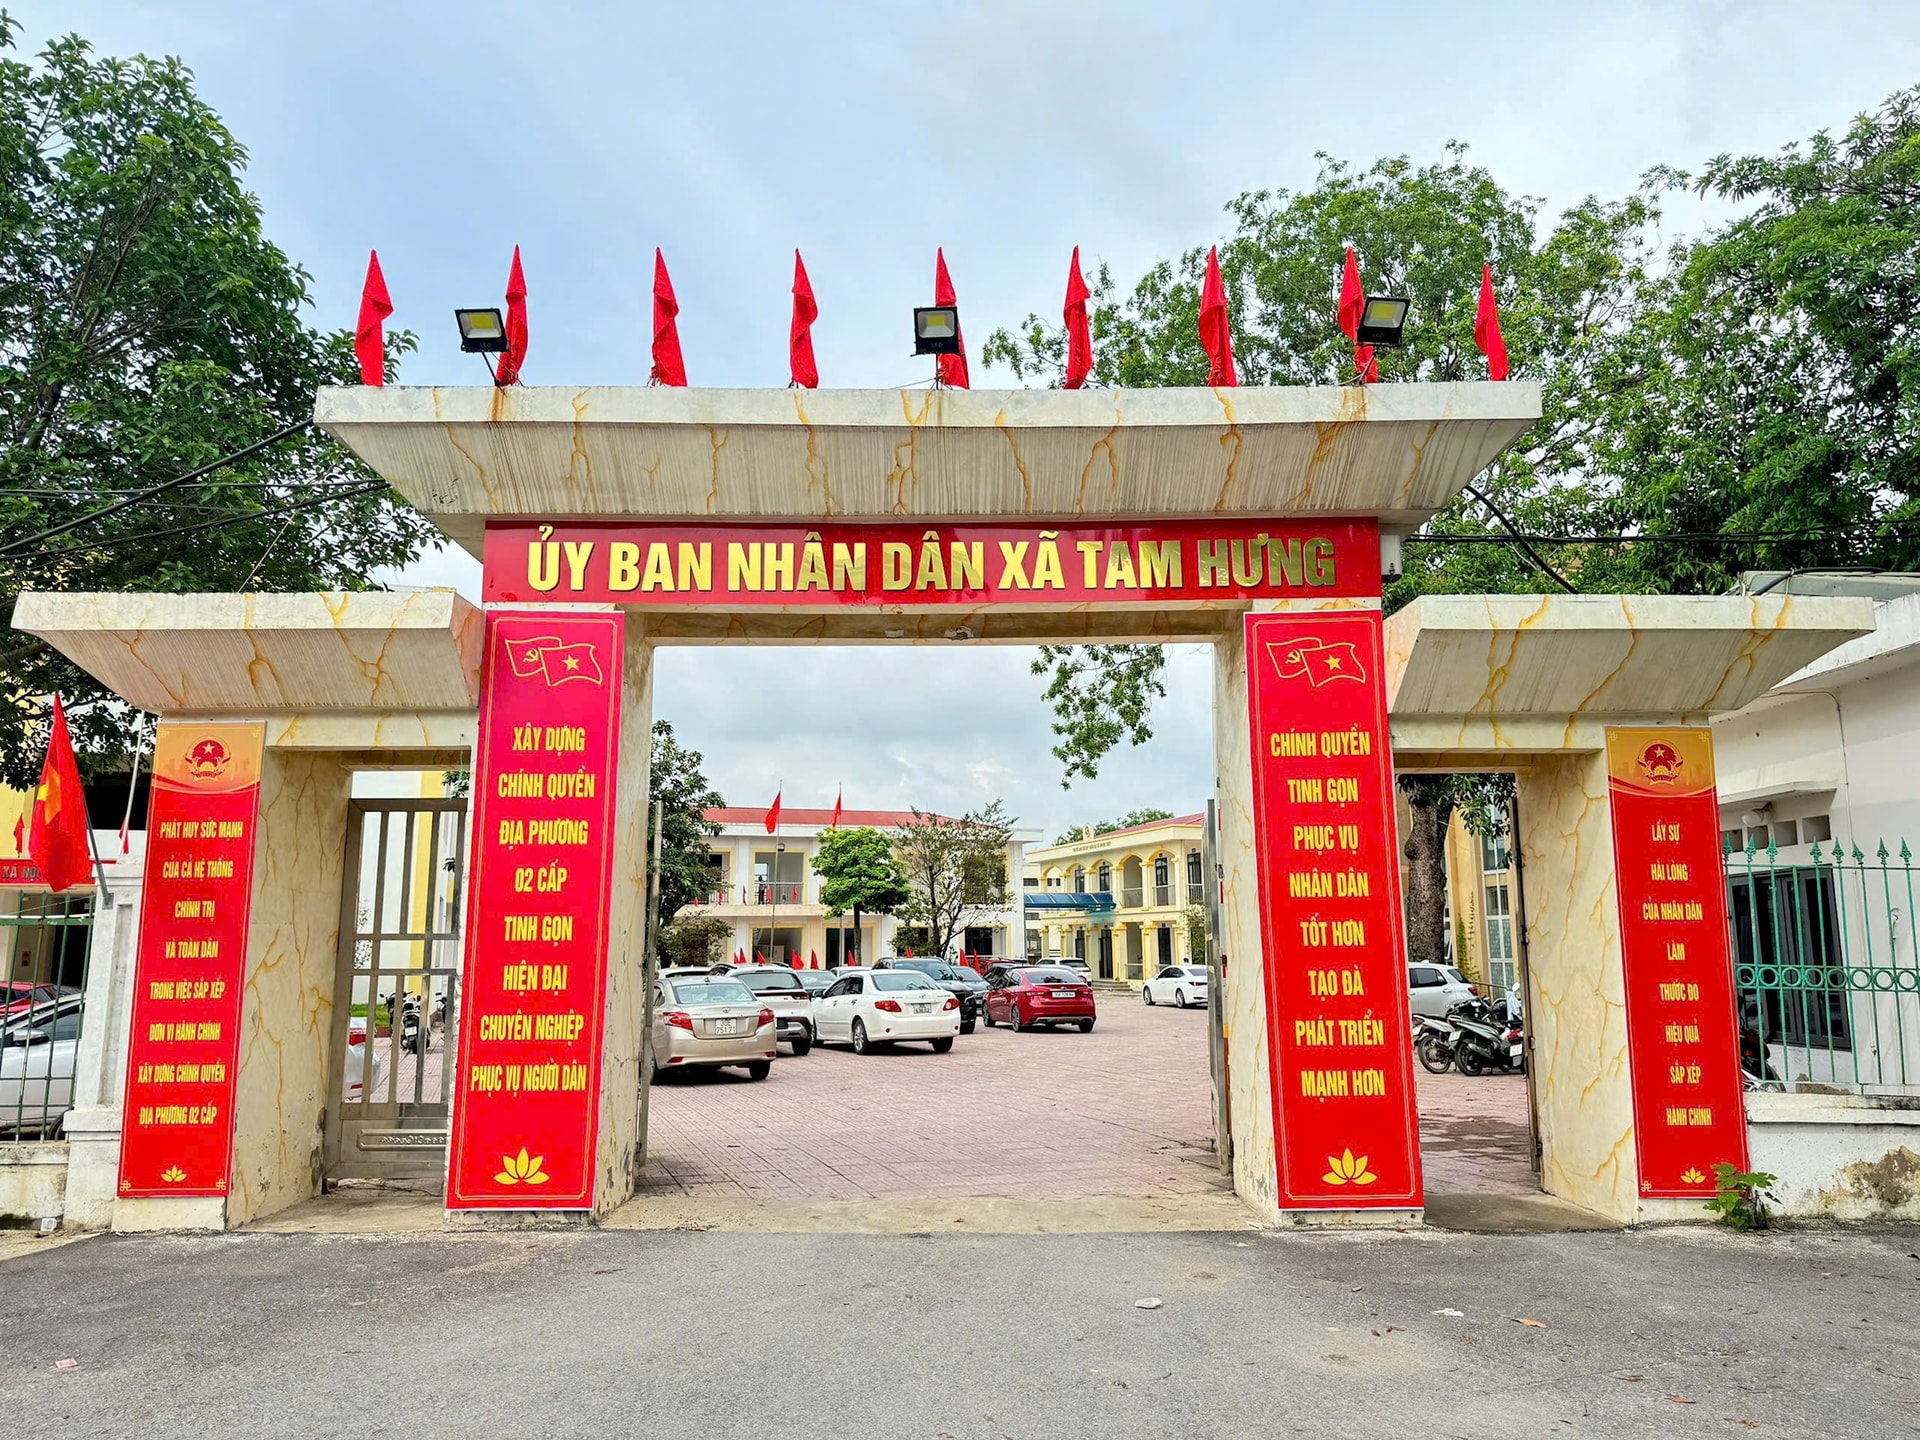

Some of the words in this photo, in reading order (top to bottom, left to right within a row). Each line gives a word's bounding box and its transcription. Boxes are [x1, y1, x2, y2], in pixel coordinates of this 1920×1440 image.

[527, 524, 595, 591] ỦY
[608, 541, 713, 592] BAN
[727, 531, 867, 592] NHÂN
[882, 530, 985, 591] DÂN
[998, 529, 1066, 590] XÃ
[1076, 540, 1183, 589] TAM
[1198, 532, 1336, 587] HƯNG
[512, 722, 542, 751] XÂY
[545, 725, 586, 756] DỰNG
[1271, 728, 1317, 757] CHÍNH
[1320, 723, 1370, 758] QUYỀN
[498, 768, 543, 798] CHÍNH
[547, 765, 595, 800] QUYỀN
[1288, 779, 1322, 803] TINH
[1327, 778, 1358, 807] GỌN
[160, 817, 182, 839] PHÁT
[182, 822, 200, 838] HUY
[200, 817, 216, 839] SỨC
[218, 821, 243, 841] MẠNH
[499, 820, 524, 850] ĐỊA
[528, 819, 589, 845] PHƯƠNG
[1293, 826, 1334, 855] PHỤC
[1338, 826, 1358, 855] VỤ
[1669, 824, 1680, 844] SỰ
[163, 854, 180, 878] CỦA
[181, 854, 192, 878] CẢ
[194, 857, 205, 881] HỆ
[515, 868, 534, 892] 02
[537, 859, 567, 892] CẤP
[1290, 868, 1332, 897] NHÂN
[1337, 867, 1369, 897] DÂN
[1651, 859, 1664, 881] HÀI
[1666, 860, 1688, 881] LÒNG
[175, 898, 201, 918] CHÍNH
[202, 900, 215, 921] TRỊ
[1643, 896, 1659, 920] CỦA
[1661, 900, 1684, 920] NHÂN
[1685, 900, 1702, 920] DÂN
[504, 916, 538, 941] TINH
[542, 915, 573, 946] GỌN
[1300, 913, 1327, 947] TỐT
[1332, 919, 1365, 946] HƠN
[165, 937, 175, 958] VÀ
[178, 937, 198, 958] TOÀN
[201, 937, 218, 958] DÂN
[1667, 940, 1685, 960] LÀM
[150, 982, 174, 999] TRONG
[175, 979, 191, 1002] VIỆC
[503, 960, 538, 996] HIỆN
[542, 965, 568, 996] ĐẠI
[1308, 970, 1337, 1001] TẠO
[1342, 965, 1364, 995] ĐÀ
[1659, 980, 1686, 1000] THƯỚC
[1687, 984, 1699, 1000] ĐO
[149, 1023, 165, 1041] ĐƠN
[167, 1023, 174, 1044] VỊ
[197, 1020, 221, 1041] CHÍNH
[480, 1009, 532, 1041] CHUYÊN
[535, 1009, 584, 1046] NGHIỆP
[1295, 1015, 1334, 1046] PHÁT
[1339, 1009, 1384, 1045] TRIỂN
[1684, 1019, 1700, 1044] QUẢ
[154, 1064, 174, 1086] DỰNG
[176, 1061, 199, 1083] CHÍNH
[471, 1065, 502, 1097] PHỤC
[506, 1065, 521, 1097] VỤ
[524, 1058, 559, 1091] NGƯỜI
[562, 1060, 586, 1091] DÂN
[1301, 1070, 1348, 1102] MẠNH
[1352, 1069, 1385, 1096] HƠN
[139, 1106, 153, 1128] ĐỊA
[155, 1105, 187, 1125] PHƯƠNG
[189, 1106, 199, 1124] 02
[201, 1100, 217, 1124] CẤP
[1688, 1104, 1712, 1126] CHÍNH
